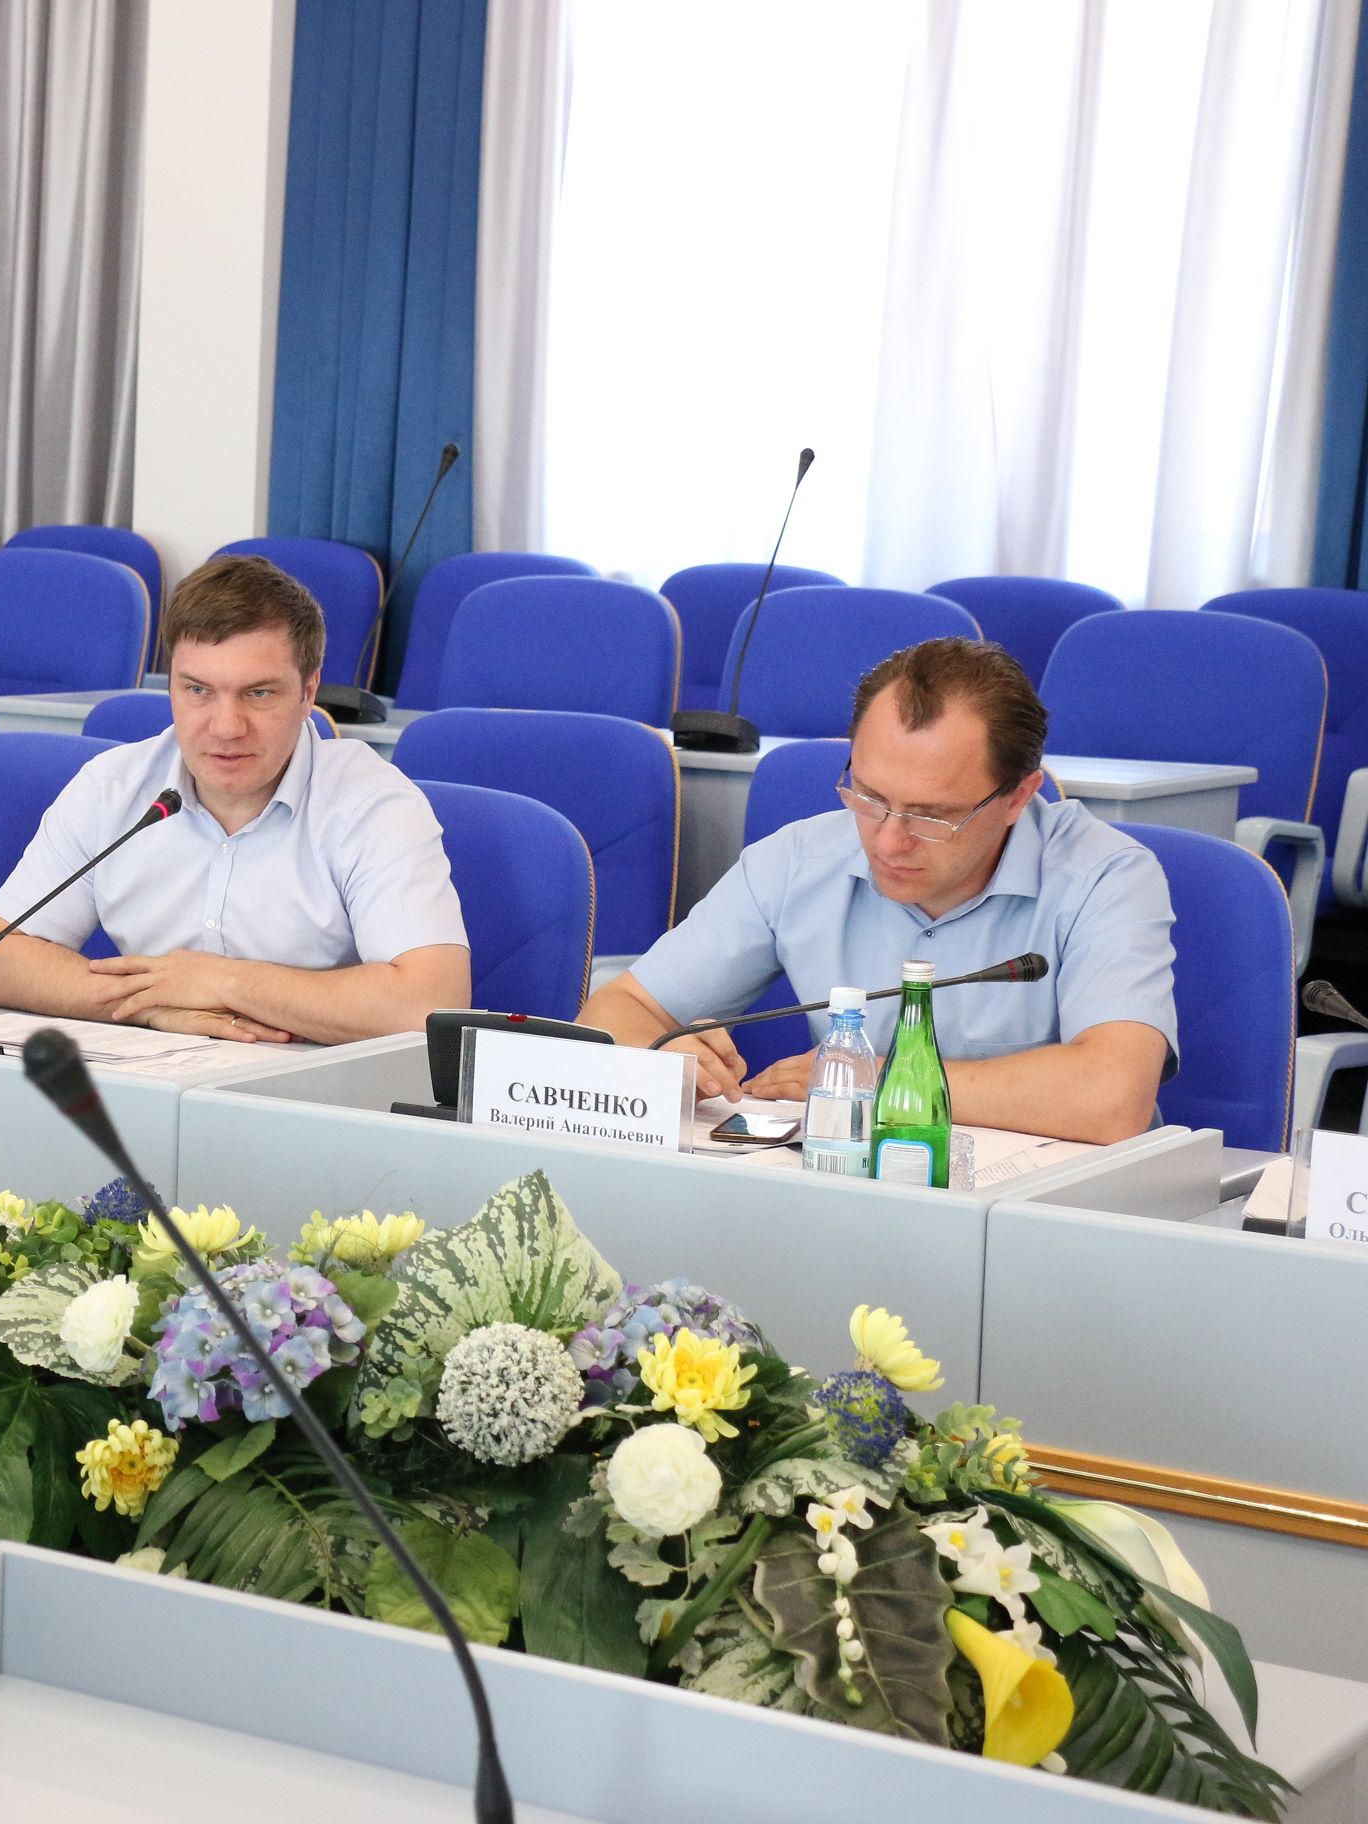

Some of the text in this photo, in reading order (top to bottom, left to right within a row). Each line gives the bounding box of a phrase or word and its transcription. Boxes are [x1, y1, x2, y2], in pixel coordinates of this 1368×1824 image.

[507, 1081, 648, 1119] САВЧЕНКО
[489, 1108, 665, 1146] Валерий Анатольевич
